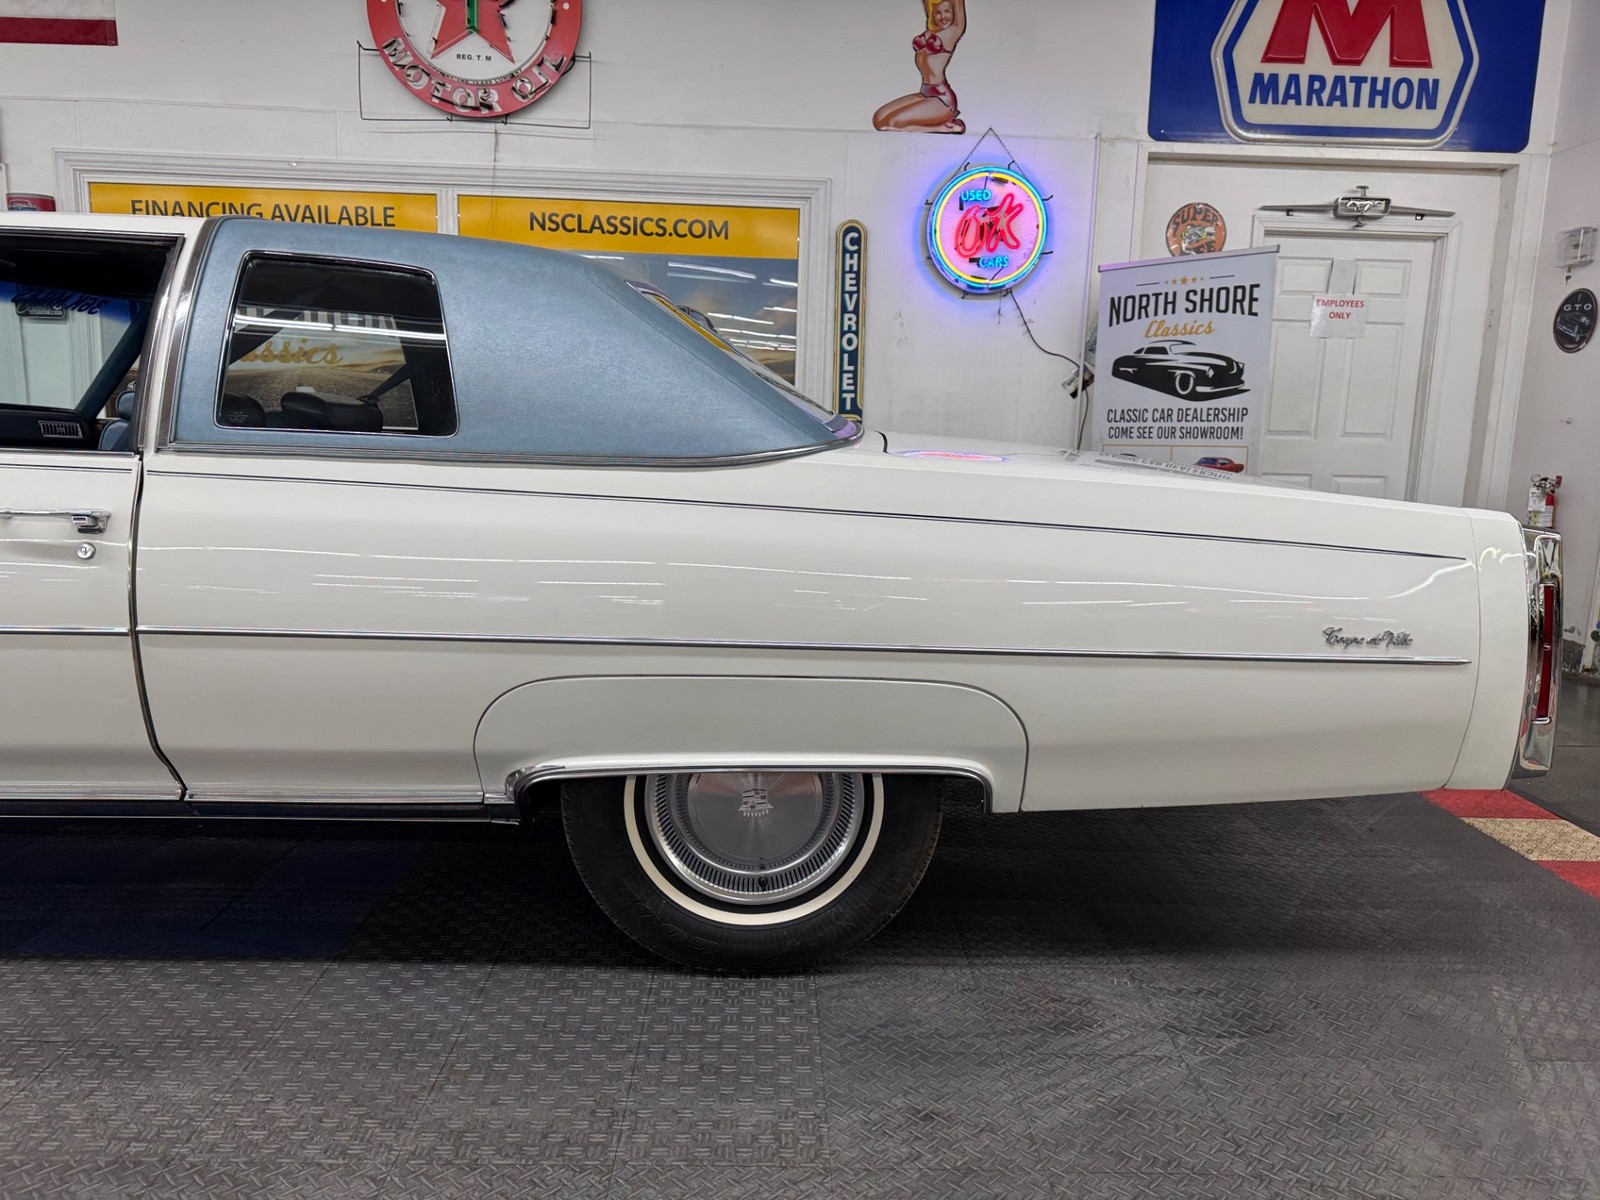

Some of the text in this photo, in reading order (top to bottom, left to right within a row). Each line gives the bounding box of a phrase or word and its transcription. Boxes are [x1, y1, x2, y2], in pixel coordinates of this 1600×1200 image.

[382, 37, 567, 114] MOTOR OIL
[1247, 72, 1440, 110] MARATHON
[960, 190, 992, 201] USED
[131, 199, 396, 228] FINANCING AVAILABLE
[1173, 206, 1219, 238] SUPER
[529, 211, 730, 240] NSCLASSICS.COM
[979, 256, 1009, 268] CARS
[1108, 284, 1260, 327] NORTH SHORE
[1316, 299, 1365, 308] EMPLOYEES
[1563, 303, 1592, 311] GTO
[840, 232, 860, 411] CHEVROLET
[1328, 311, 1352, 320] ONLY
[1144, 319, 1215, 338] Classics
[1106, 407, 1249, 423] CLASSIC CAR DEALERSHIP
[1108, 426, 1244, 440] COME SEE OUR SHOWROOM!
